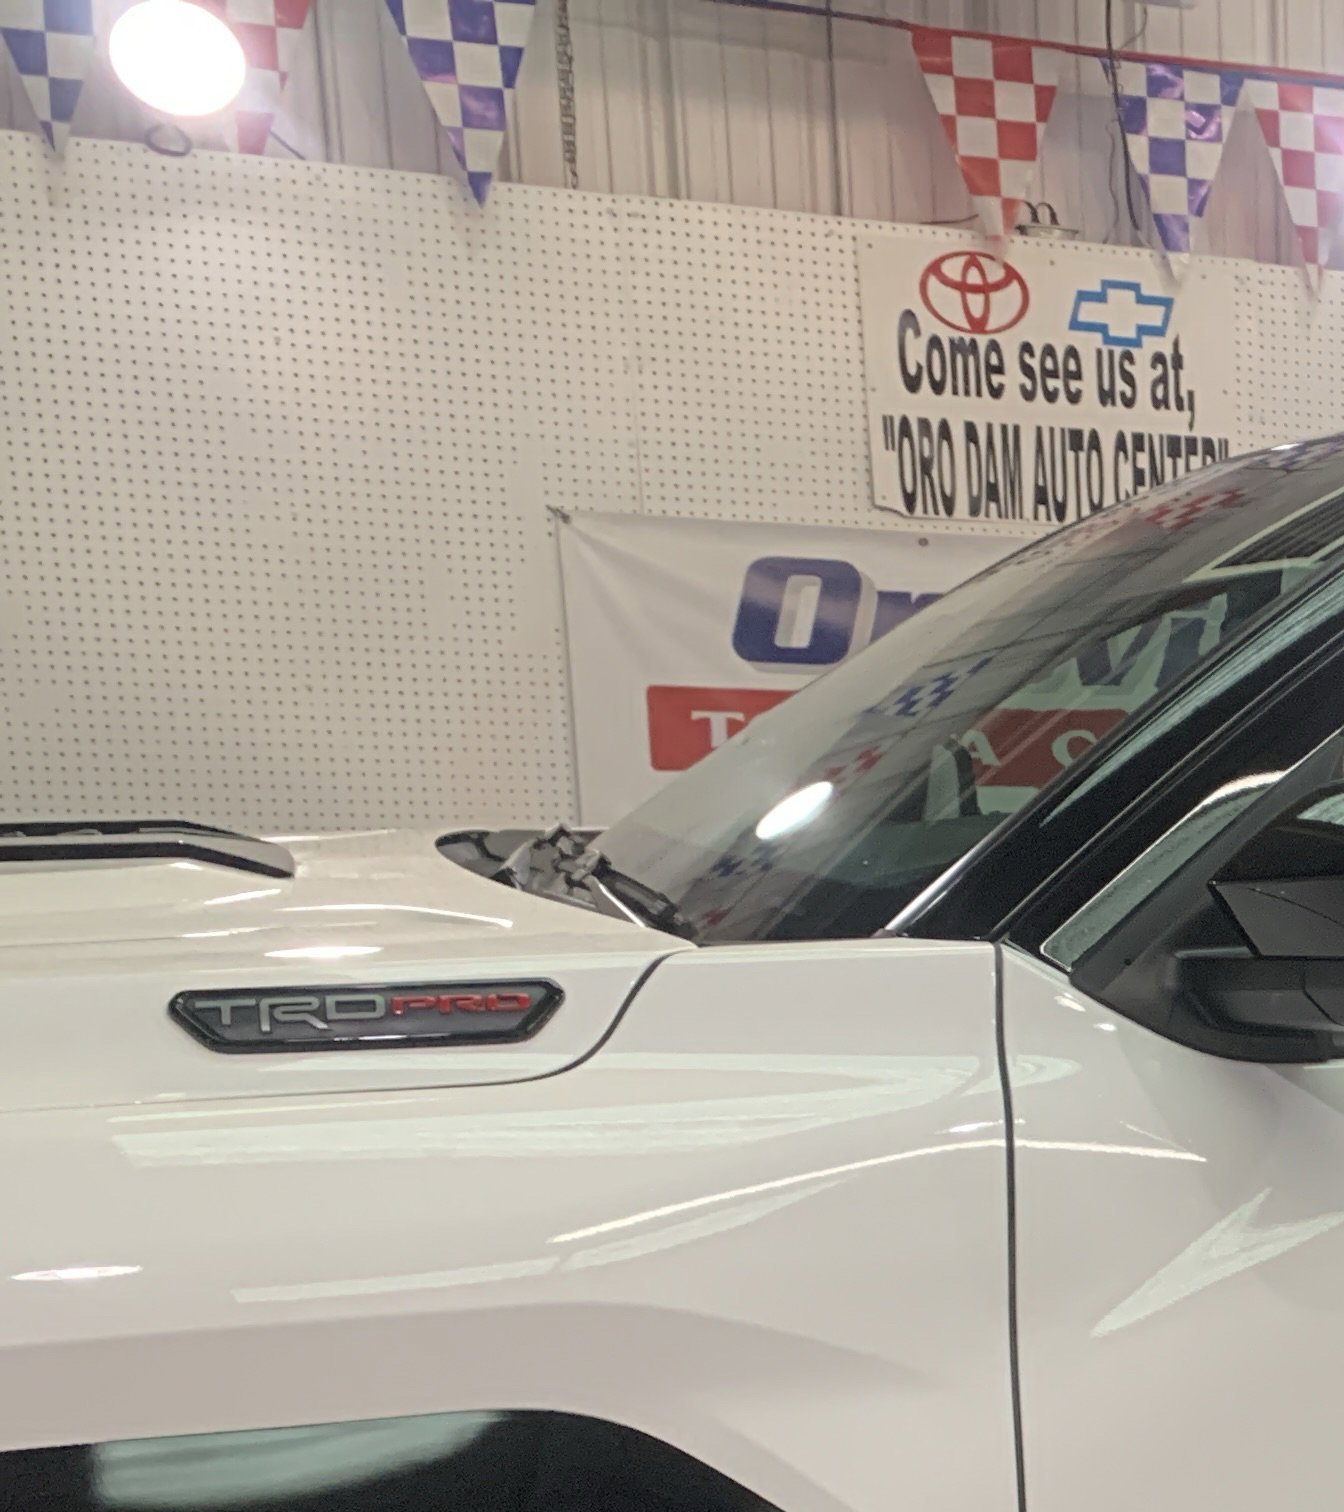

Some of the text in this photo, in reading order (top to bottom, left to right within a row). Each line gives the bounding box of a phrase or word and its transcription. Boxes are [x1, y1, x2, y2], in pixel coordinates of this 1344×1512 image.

[898, 309, 1195, 432] Come see us at,
[882, 414, 956, 517] "ORO
[964, 420, 1024, 521] DAM
[1033, 426, 1104, 523] AUTO
[195, 992, 531, 1034] TRD PRO
